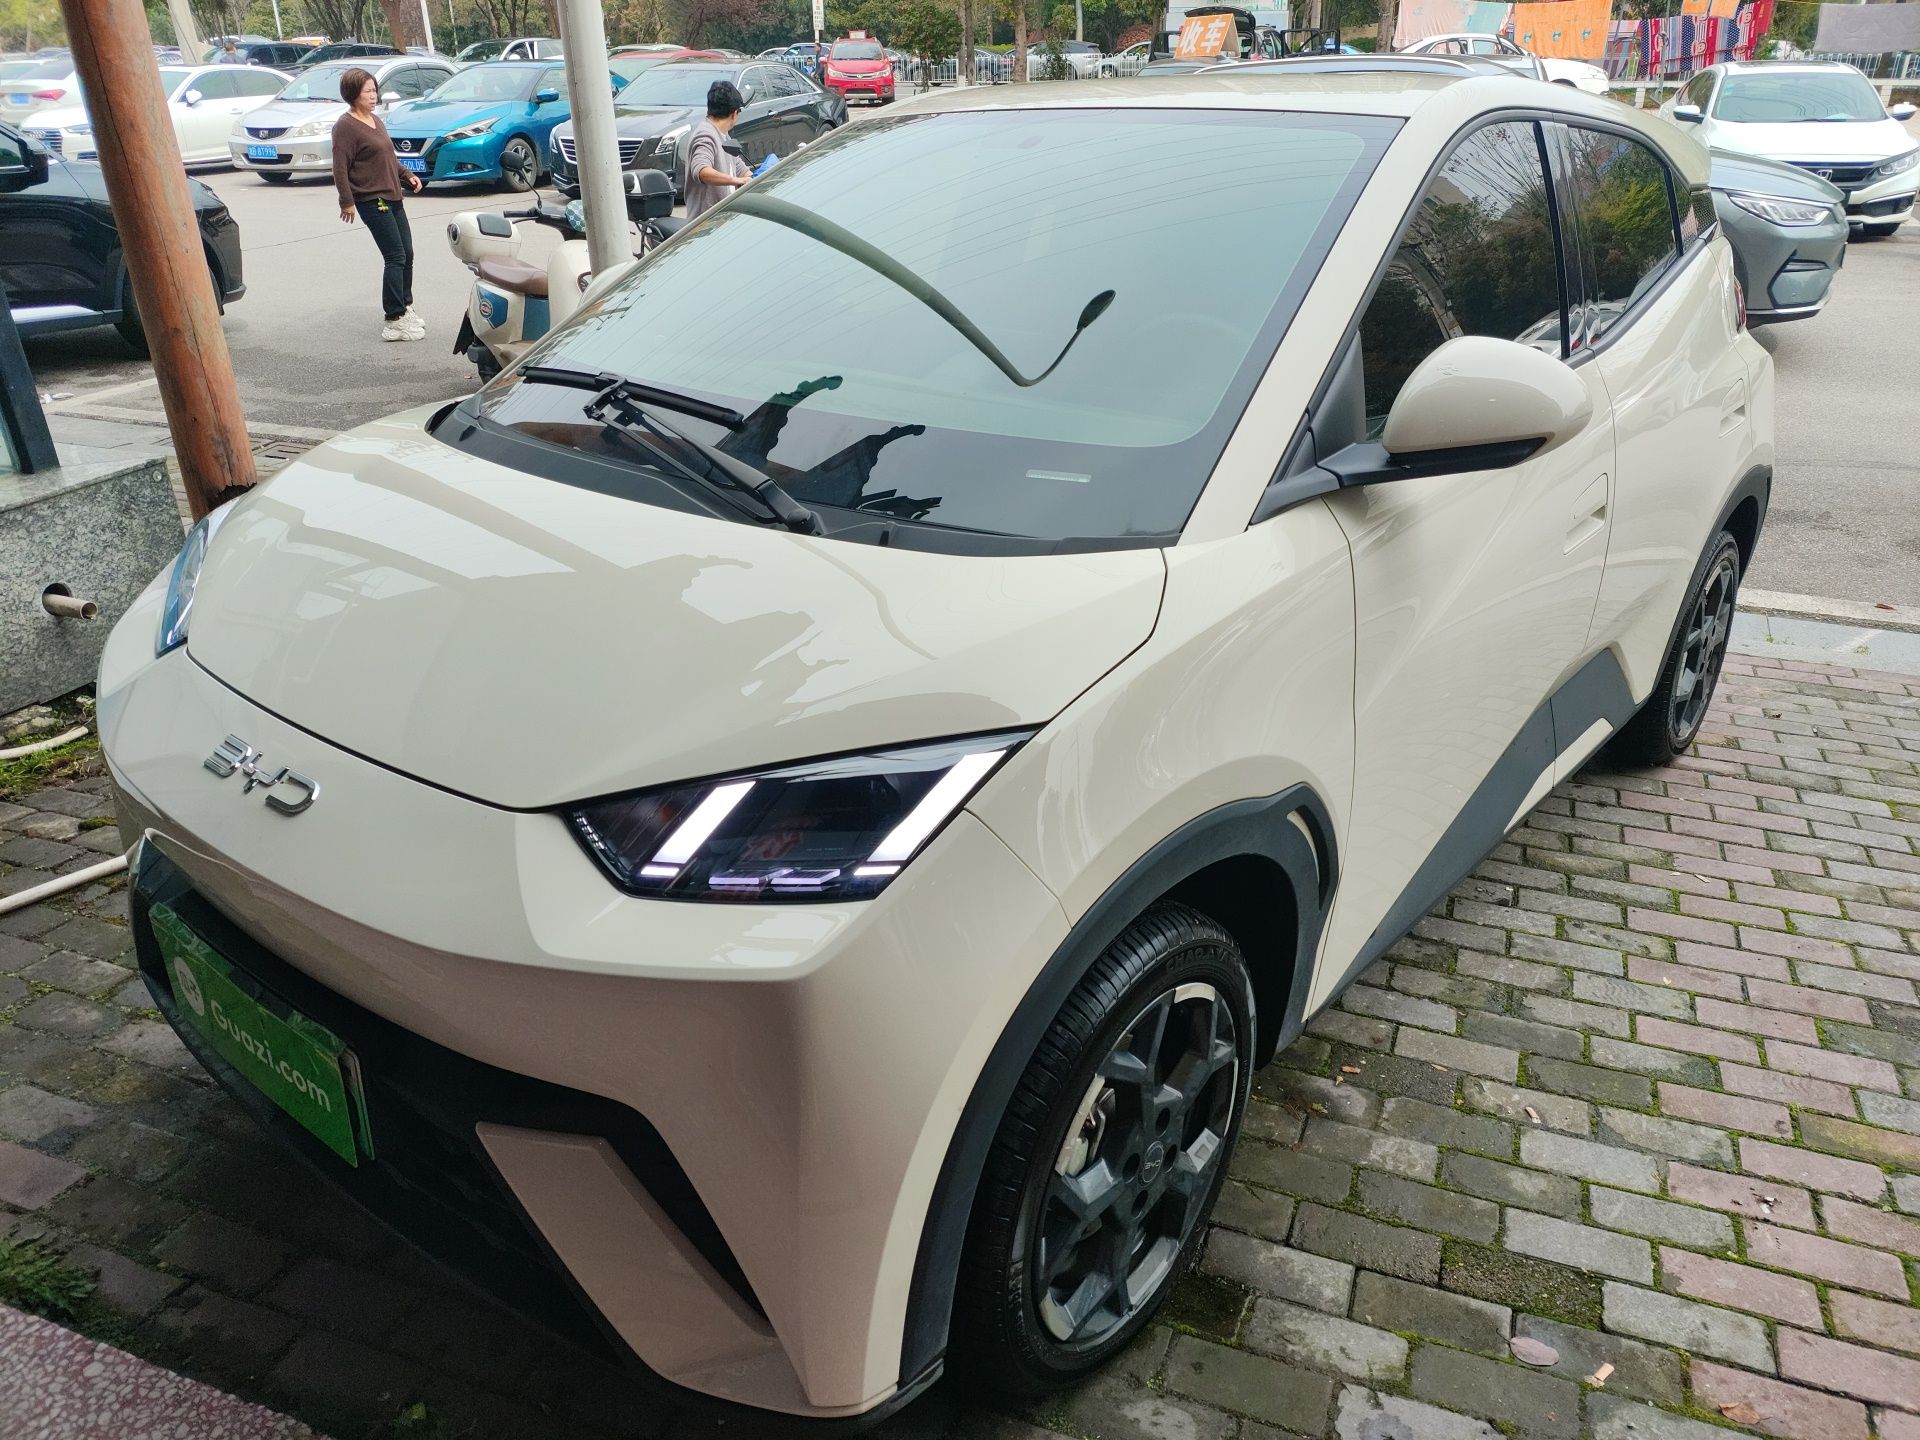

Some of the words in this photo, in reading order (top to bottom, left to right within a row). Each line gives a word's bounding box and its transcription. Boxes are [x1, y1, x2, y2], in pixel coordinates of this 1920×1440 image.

[1180, 19, 1227, 54] 收车
[203, 733, 320, 817] BYD
[210, 1000, 331, 1112] Guazi.com
